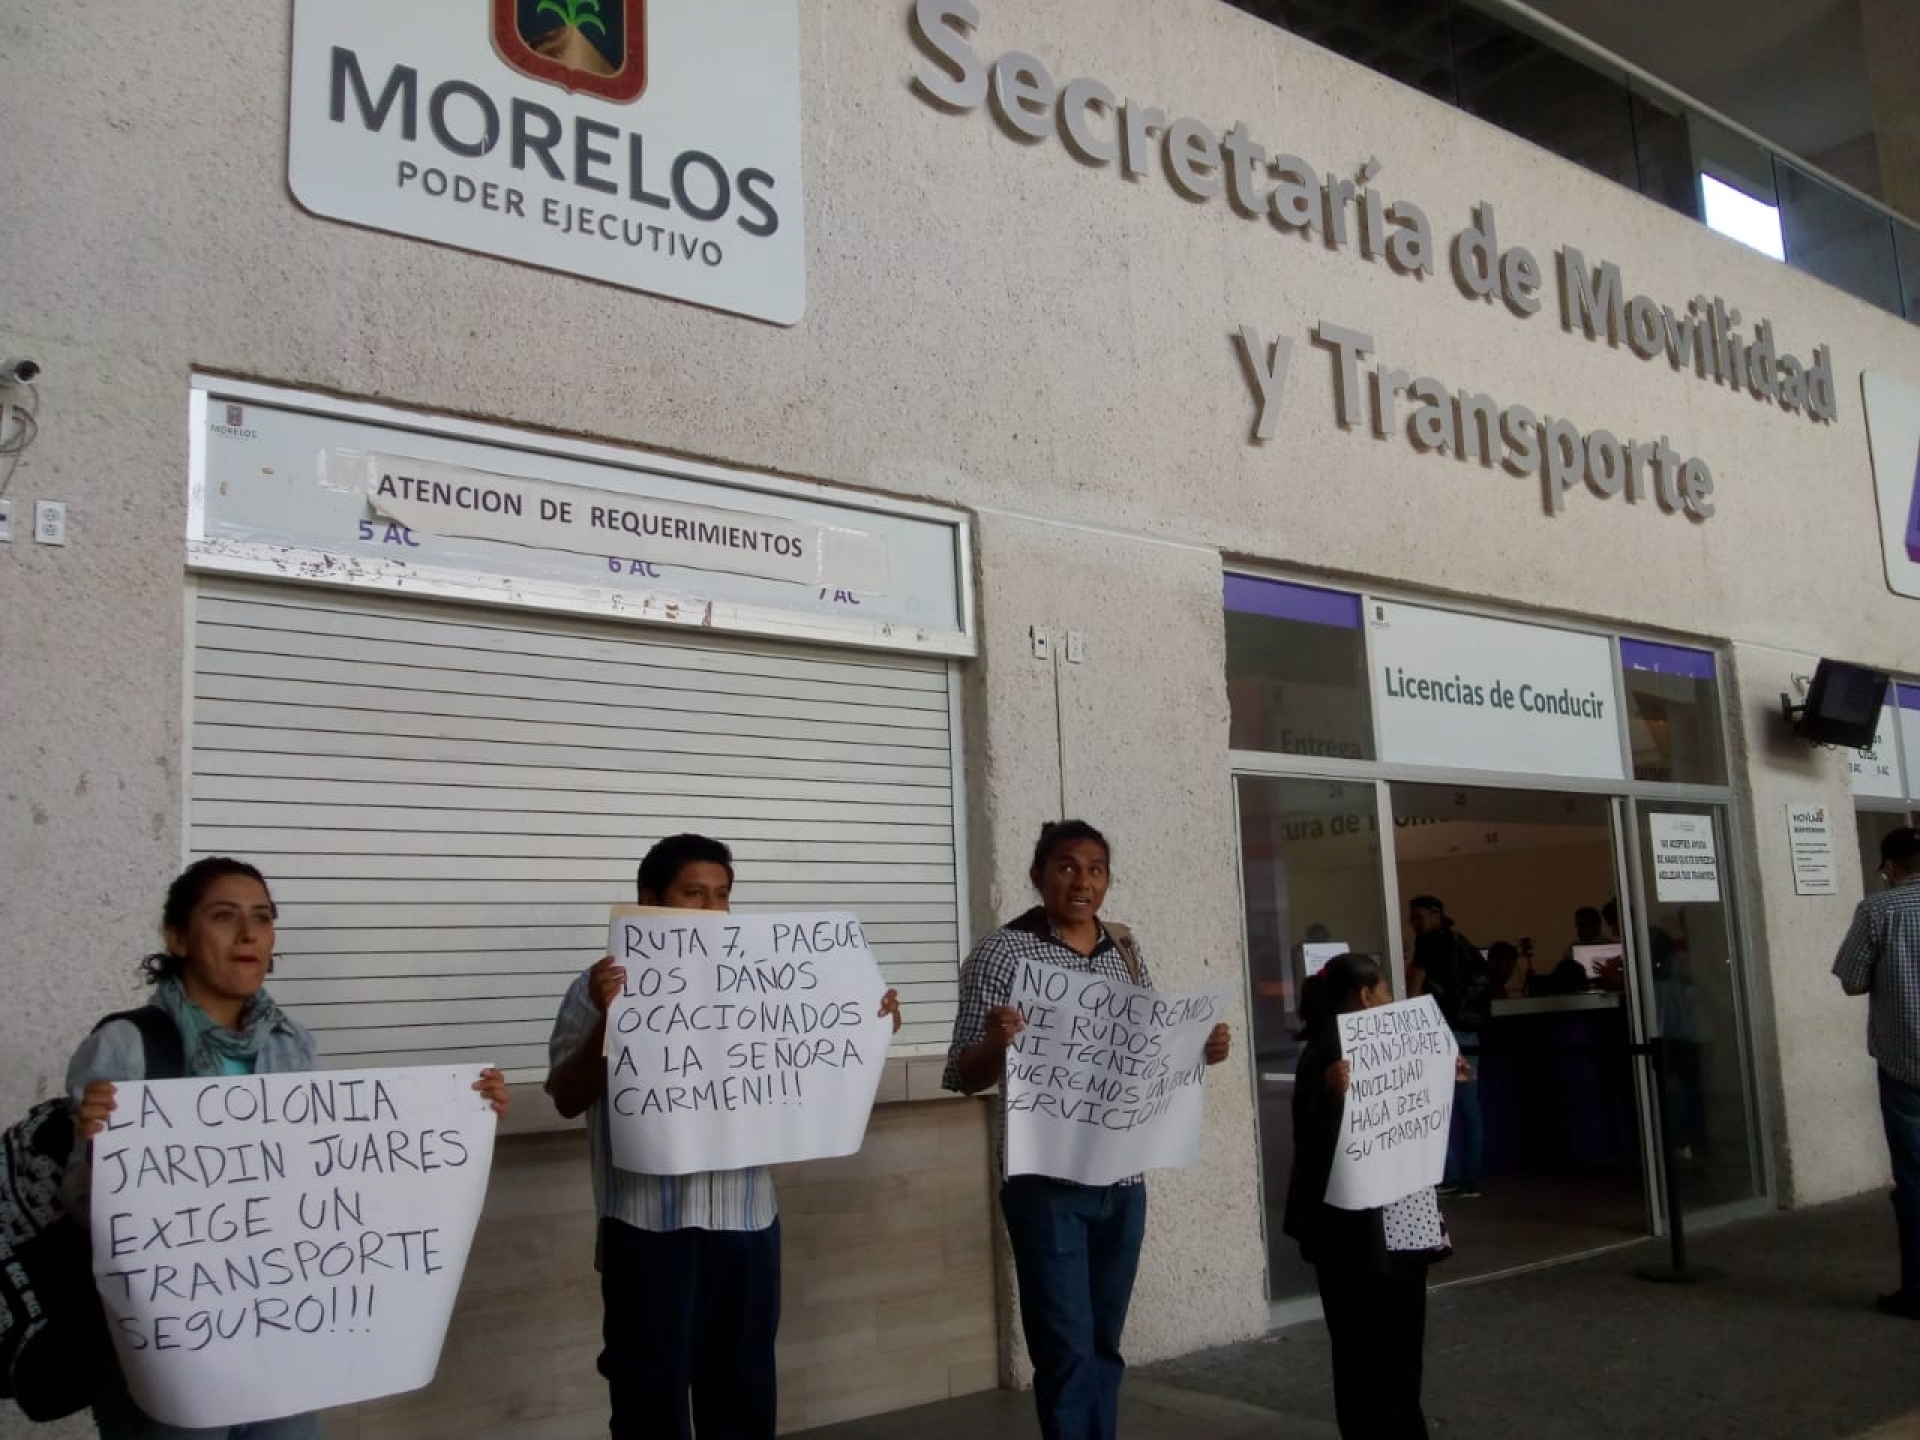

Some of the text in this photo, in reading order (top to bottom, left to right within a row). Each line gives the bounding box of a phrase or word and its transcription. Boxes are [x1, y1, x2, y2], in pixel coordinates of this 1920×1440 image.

[330, 45, 780, 238] MORELOS
[398, 161, 723, 267] PODER EJECUTIVO
[911, 0, 1838, 425] Secretaría de Movilidad
[1236, 319, 1716, 517] y Transporte
[359, 519, 421, 547] 5 AC
[377, 474, 803, 558] ATENCION DE REQUERIMIENTOS
[608, 555, 661, 578] 6 AC
[1385, 667, 1605, 719] Licencias de Conducir
[624, 923, 709, 960] RUTA
[721, 926, 745, 959] 7,
[622, 958, 818, 999] LOS DAÑOS
[1023, 962, 1219, 1029] NO QUEREMOS
[617, 1000, 863, 1036] OCACIONADOS
[1016, 1001, 1162, 1058] NI RUDOS
[1345, 1007, 1431, 1042] SECRETARIA
[614, 1037, 864, 1078] A LA SEÑORA
[1345, 1031, 1442, 1071] TRANSPORTE
[105, 1077, 399, 1130] LA COLONIA
[614, 1069, 803, 1117] CARMEN!!!
[1350, 1058, 1424, 1104] MOVILIDAD
[1350, 1085, 1430, 1134] HAGA BIEN
[102, 1128, 469, 1195] JARDIN JUARES
[1345, 1138, 1373, 1162] SU
[110, 1186, 364, 1260] EXIGE UN
[106, 1228, 445, 1302] TRANSPORTE
